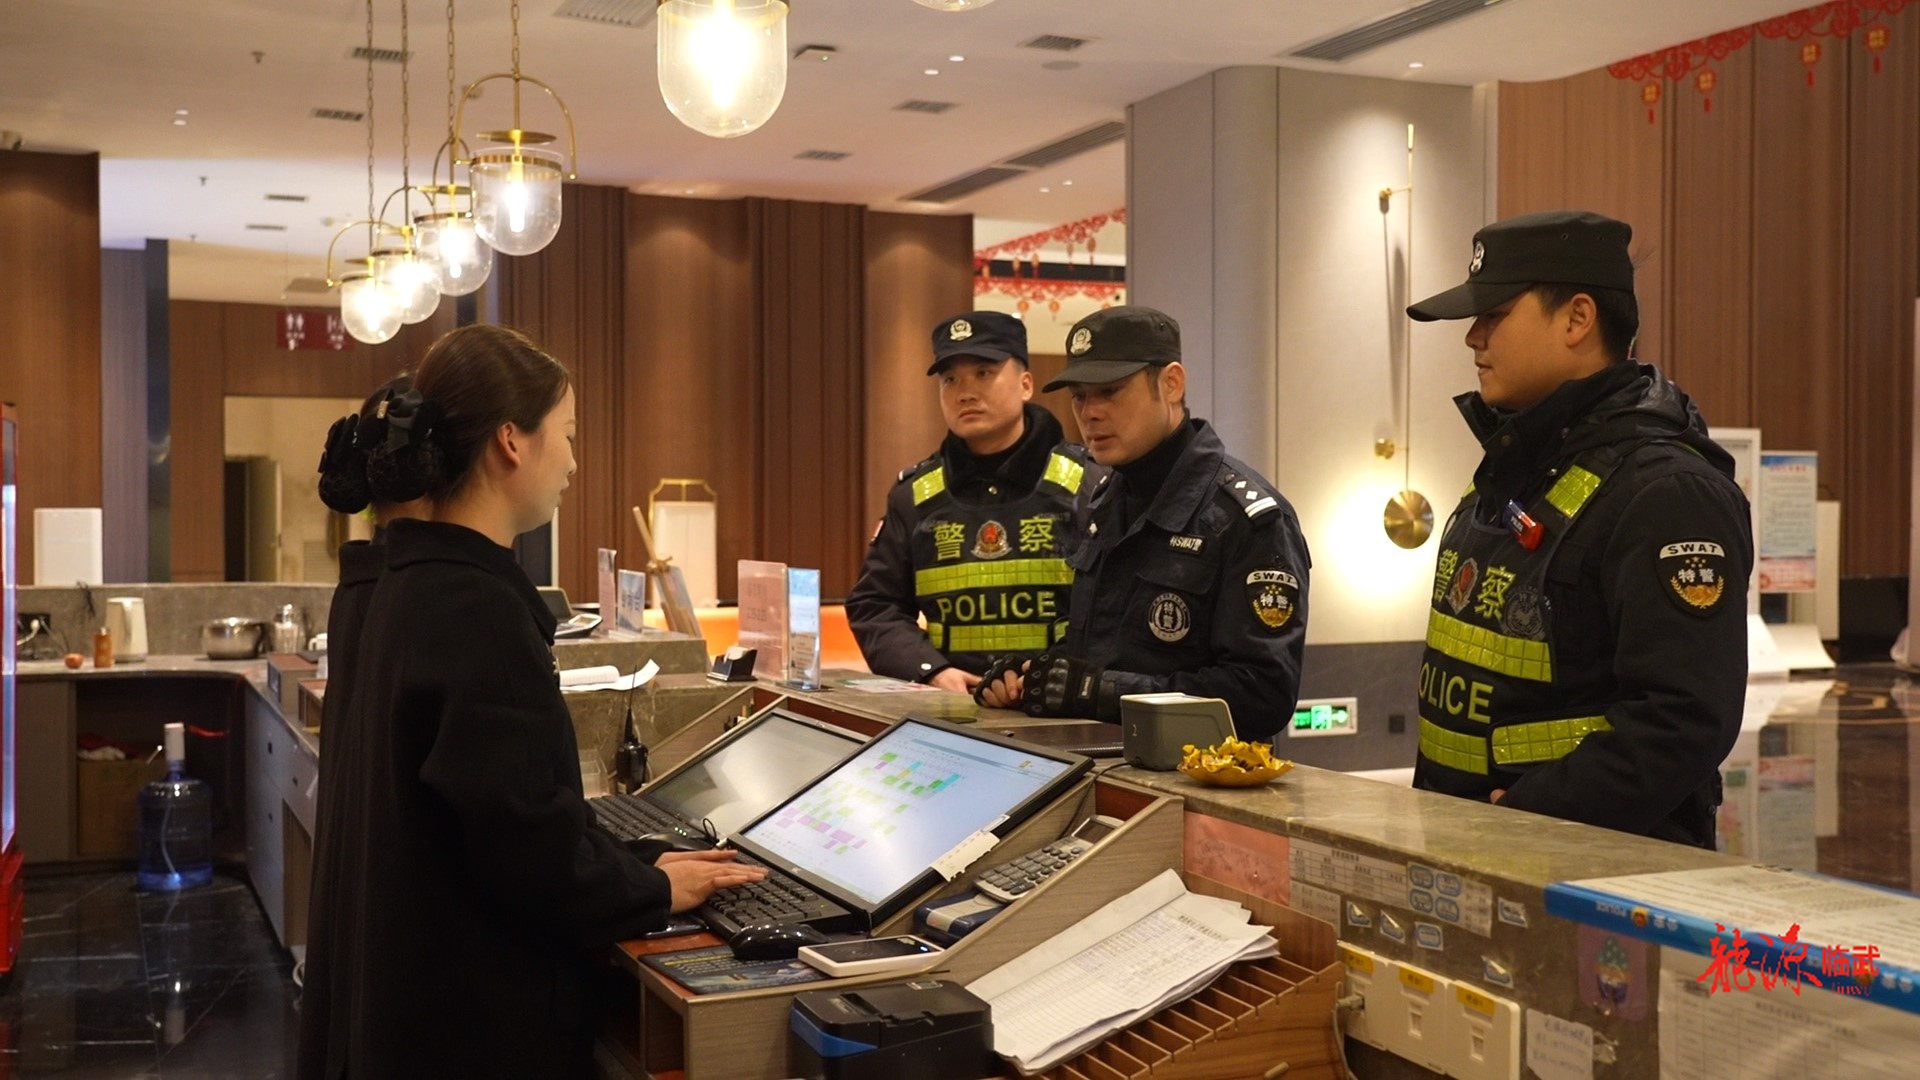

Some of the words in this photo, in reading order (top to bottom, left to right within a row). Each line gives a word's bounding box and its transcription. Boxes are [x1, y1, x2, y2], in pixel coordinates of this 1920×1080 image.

[1667, 543, 1718, 555] SWAT
[1253, 571, 1295, 584] SWAT
[1677, 568, 1715, 583] 特警
[936, 591, 1057, 622] POLICE
[1260, 593, 1288, 609] 特警
[1417, 661, 1495, 724] OLICE
